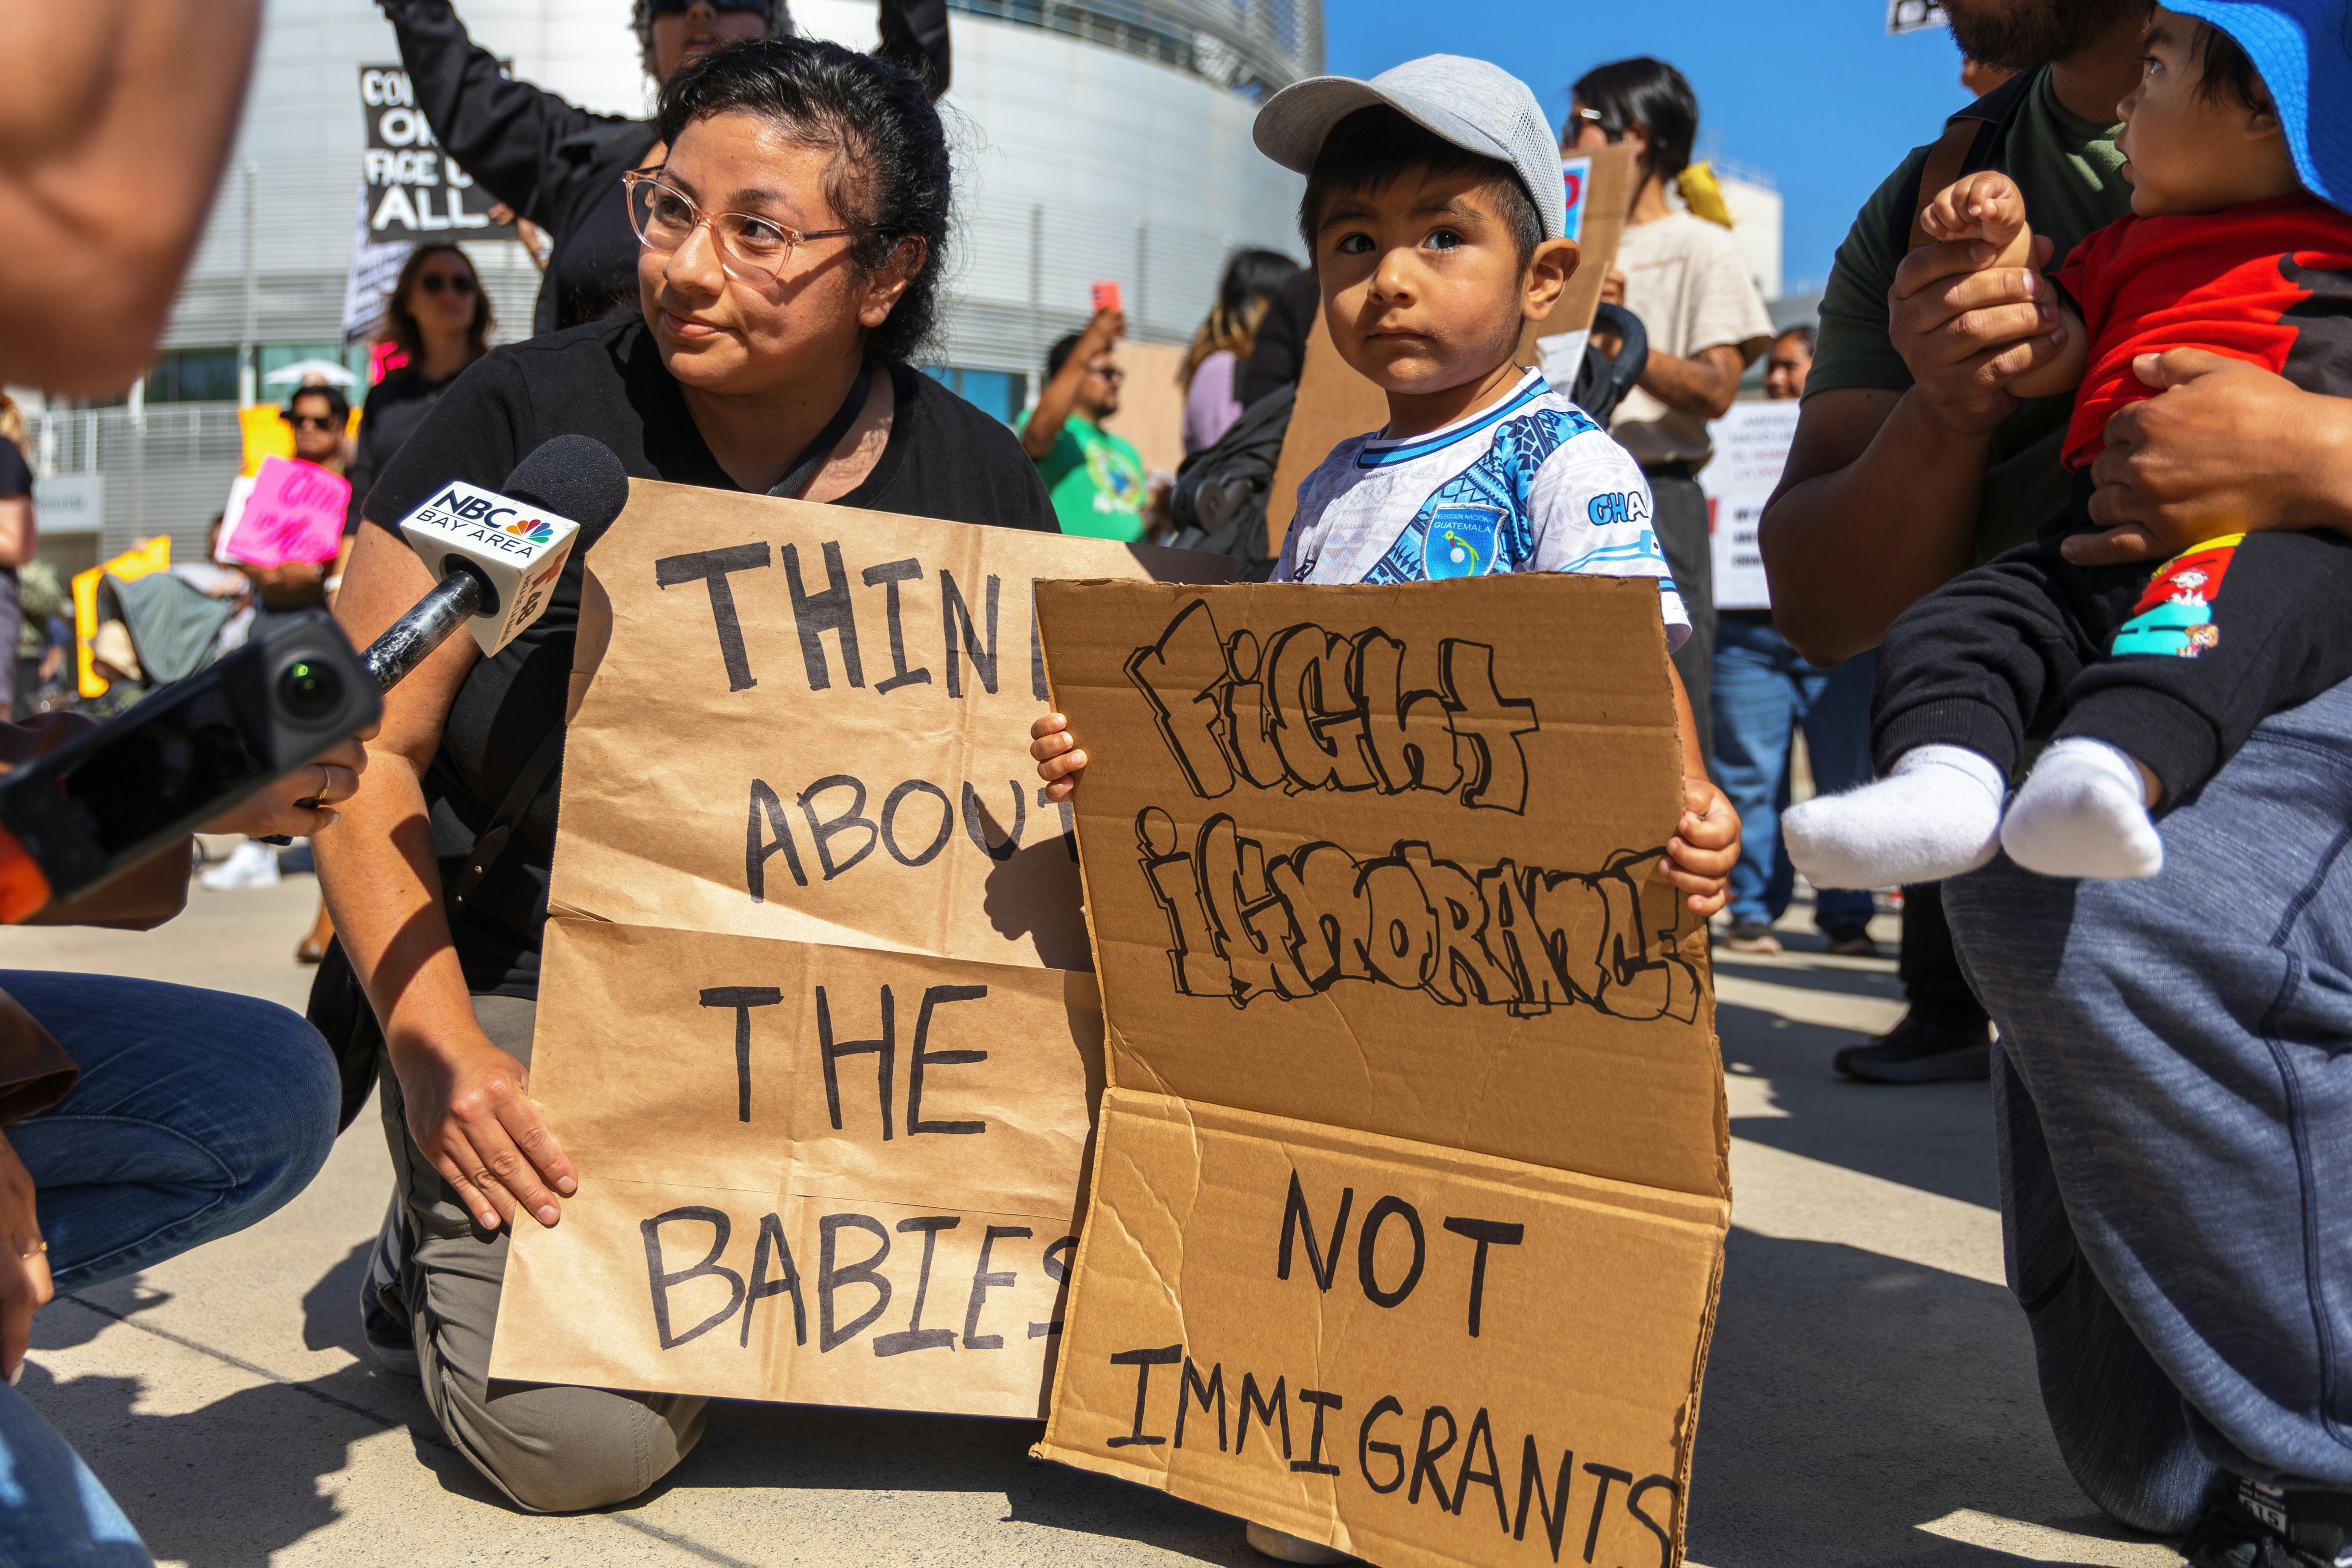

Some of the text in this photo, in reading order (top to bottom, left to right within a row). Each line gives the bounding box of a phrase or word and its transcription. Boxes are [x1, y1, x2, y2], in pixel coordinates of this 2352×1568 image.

[365, 149, 440, 187] FACE
[371, 184, 491, 231] ALL
[432, 489, 518, 529] NBC
[1434, 521, 1491, 534] GUATEMALA
[1464, 514, 1495, 524] NACIONAL
[416, 510, 533, 558] BAY AREA
[509, 606, 519, 621] LA
[514, 595, 524, 609] DE
[516, 591, 543, 626] 48
[655, 540, 1049, 701] THIN
[699, 984, 988, 1140] THE
[1277, 1169, 1524, 1337] NOT
[1106, 1344, 1680, 1568] IMMIGRANTS
